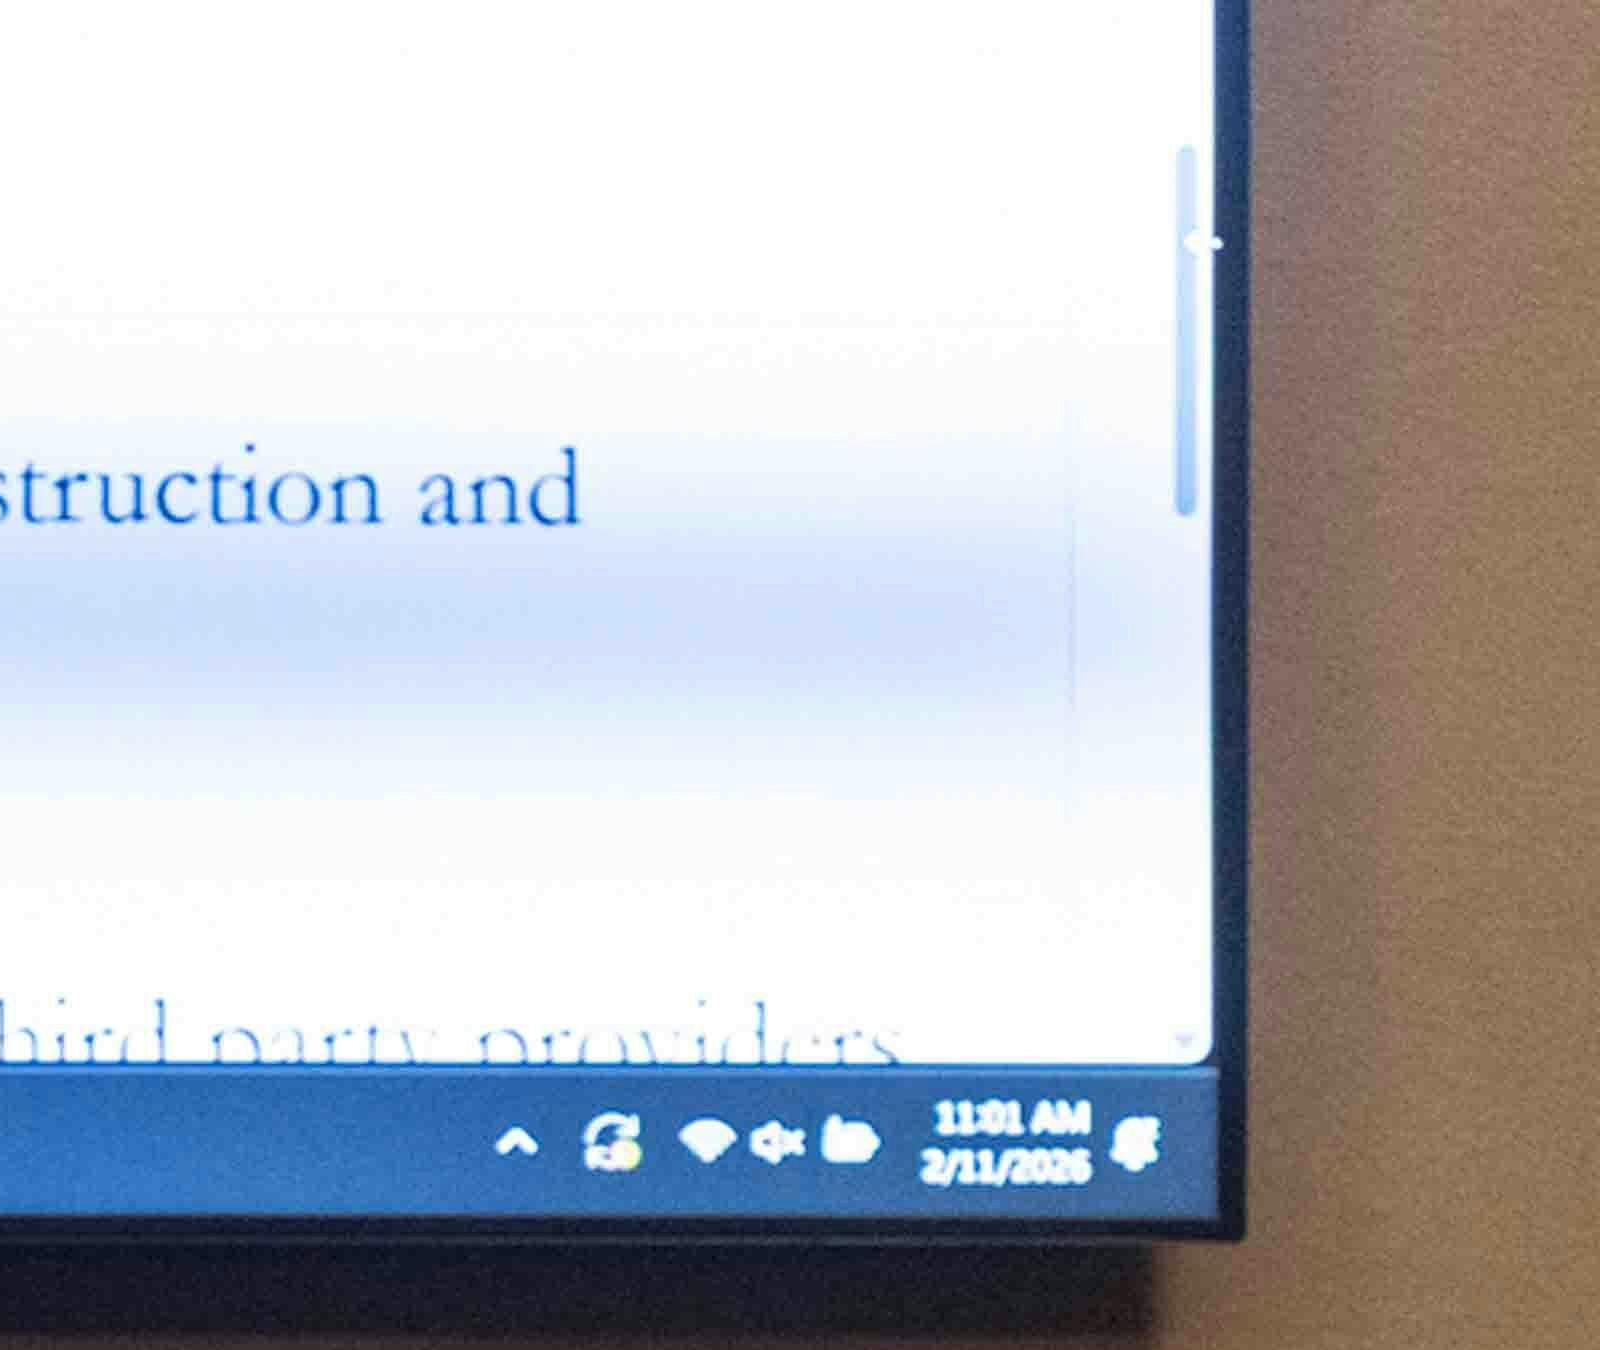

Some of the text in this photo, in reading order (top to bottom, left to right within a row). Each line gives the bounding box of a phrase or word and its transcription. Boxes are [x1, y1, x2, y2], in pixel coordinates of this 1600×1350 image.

[417, 444, 584, 529] and
[934, 1099, 1092, 1136] 11:01 AM
[919, 1147, 1093, 1187] 2/11/2026
